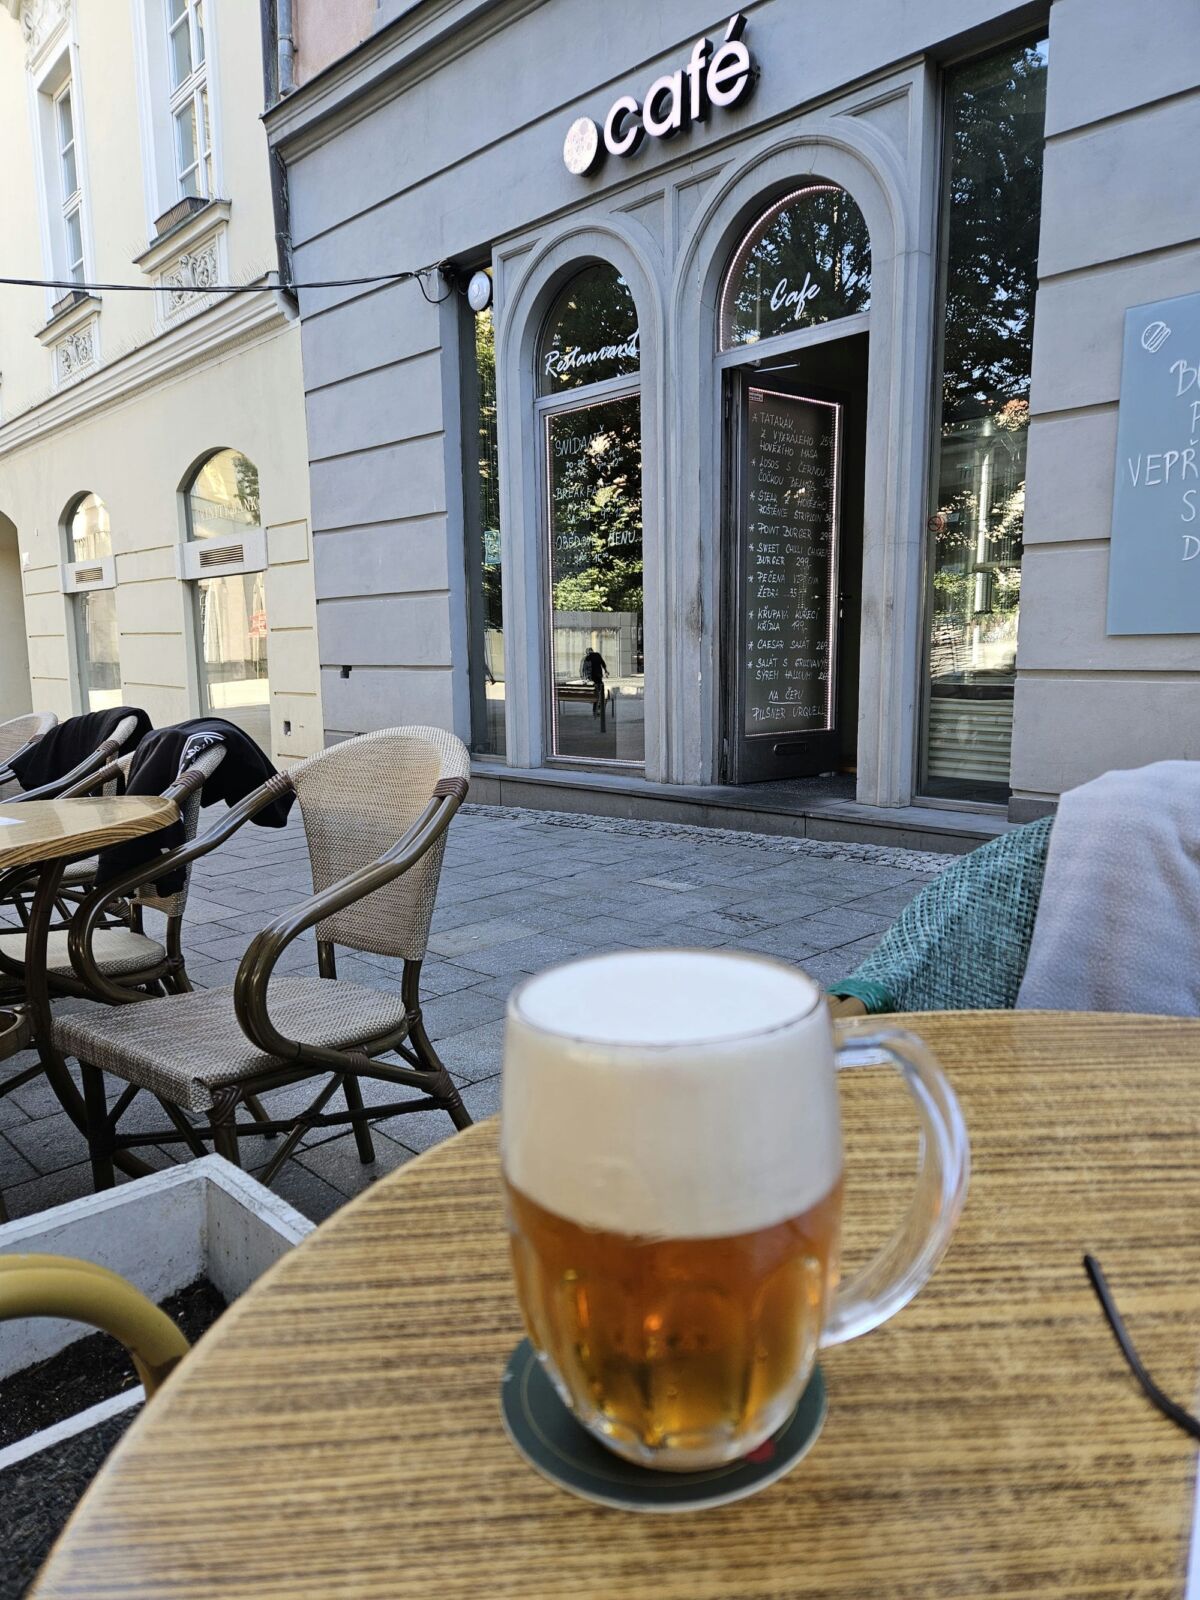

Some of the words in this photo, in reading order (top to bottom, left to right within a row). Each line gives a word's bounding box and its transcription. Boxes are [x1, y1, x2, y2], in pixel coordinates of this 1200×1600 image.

[603, 13, 752, 157] café
[769, 272, 821, 318] Cafe
[544, 327, 641, 378] Restaurant
[756, 542, 780, 553] SWEET
[756, 555, 785, 566] BURGER
[757, 638, 785, 650] CAESAR
[768, 689, 779, 700] NA
[752, 706, 786, 721] PILSNER
